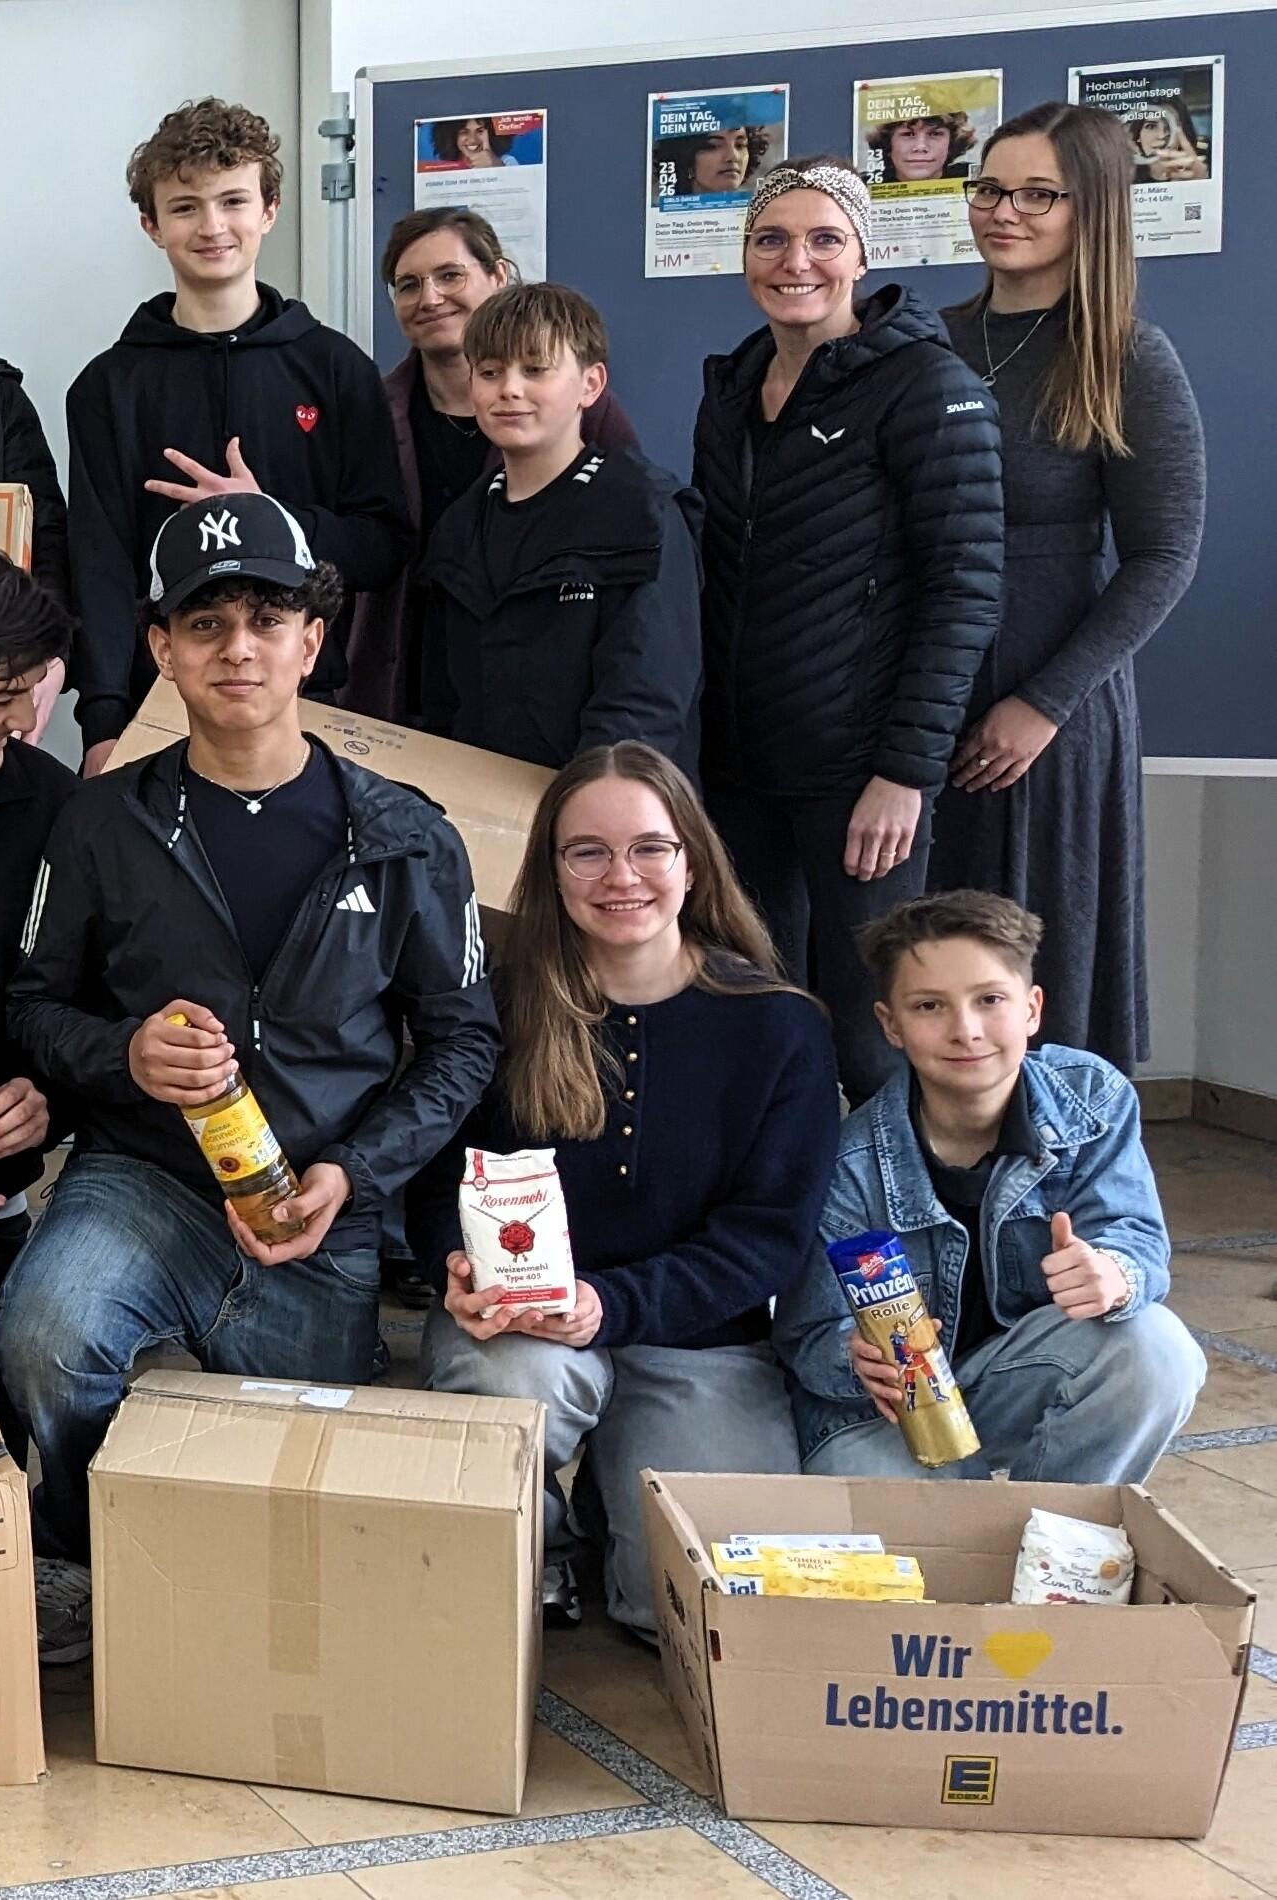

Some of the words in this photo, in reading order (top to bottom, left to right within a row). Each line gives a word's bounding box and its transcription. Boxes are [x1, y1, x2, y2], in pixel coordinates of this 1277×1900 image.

[1086, 77, 1150, 91] Hochschul-
[1086, 86, 1181, 102] informationstage
[867, 99, 896, 110] DEIN
[660, 112, 686, 124] DEIN
[689, 110, 716, 122] TAG,
[867, 109, 895, 120] DEIN
[898, 106, 931, 118] WEG!
[660, 124, 686, 135] DEIN
[689, 121, 721, 132] WEG!
[867, 149, 883, 161] 23
[659, 162, 675, 173] 23
[866, 161, 886, 172] 04
[659, 173, 677, 185] 04
[866, 172, 883, 184] 26
[659, 185, 675, 196] 26
[654, 254, 682, 268] HM
[198, 509, 242, 552] NY
[480, 1189, 548, 1209] Rosenmehl
[494, 1263, 549, 1274] Weizenmehl
[505, 1274, 525, 1284] Type
[847, 1273, 913, 1305] Prinzen
[870, 1302, 911, 1319] Rolle
[726, 1547, 753, 1559] ja!
[1040, 1571, 1070, 1590] Zum
[892, 1633, 972, 1679] Wir
[825, 1682, 1123, 1736] Lebensmittel.
[948, 1793, 989, 1801] EDEKA
